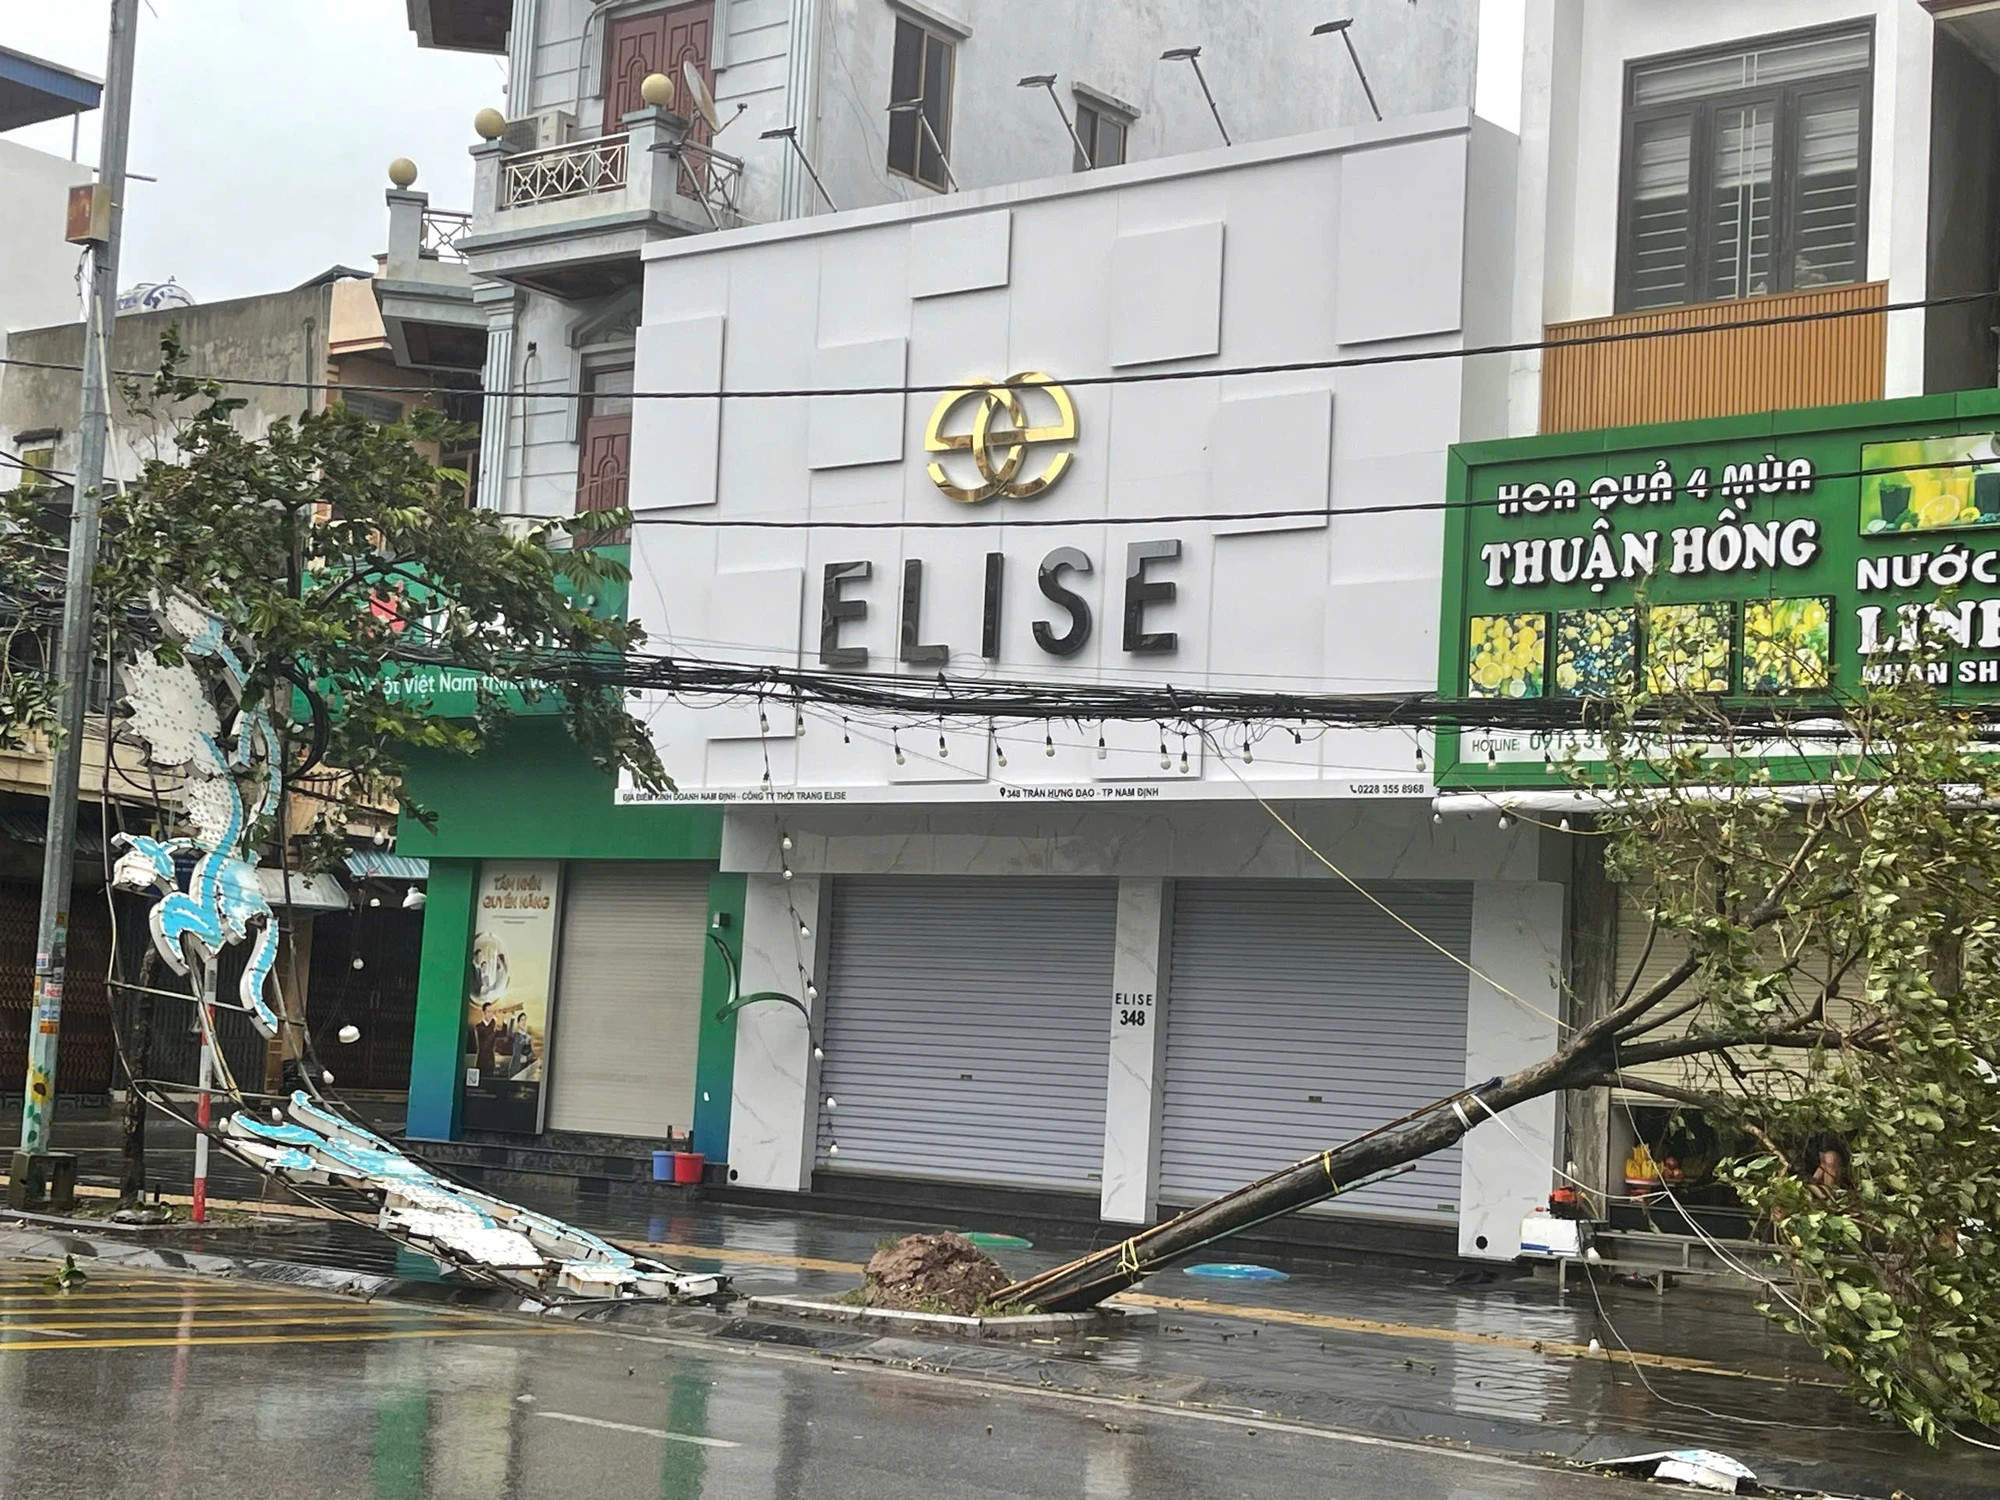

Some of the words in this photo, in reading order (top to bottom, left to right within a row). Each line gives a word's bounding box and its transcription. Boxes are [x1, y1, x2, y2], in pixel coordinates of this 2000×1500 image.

[1498, 479, 1577, 514] HOA
[1589, 460, 1673, 510] QUẢ
[1685, 468, 1708, 498] 4
[1721, 453, 1811, 496] MÙA
[1480, 516, 1658, 592] THUẬN
[1669, 497, 1817, 574] HỒNG
[1856, 544, 1998, 590] NƯỚC
[819, 539, 1182, 665] ELISE
[404, 674, 435, 699] Việt
[440, 673, 478, 692] Nam
[674, 792, 699, 801] DOANH
[701, 791, 717, 801] NAM
[742, 789, 764, 801] CÔNG
[796, 791, 823, 801] TRANG
[824, 791, 846, 801] ELISE
[1023, 787, 1046, 797] TRẦN
[1047, 788, 1073, 798] HƯNG
[1075, 788, 1095, 799] ĐẠO
[1102, 788, 1113, 797] TP
[1115, 787, 1135, 797] NAM
[1357, 784, 1380, 794] 0228
[1383, 784, 1400, 794] 355
[1115, 992, 1153, 1006] ELISE
[1120, 1009, 1146, 1026] 348
